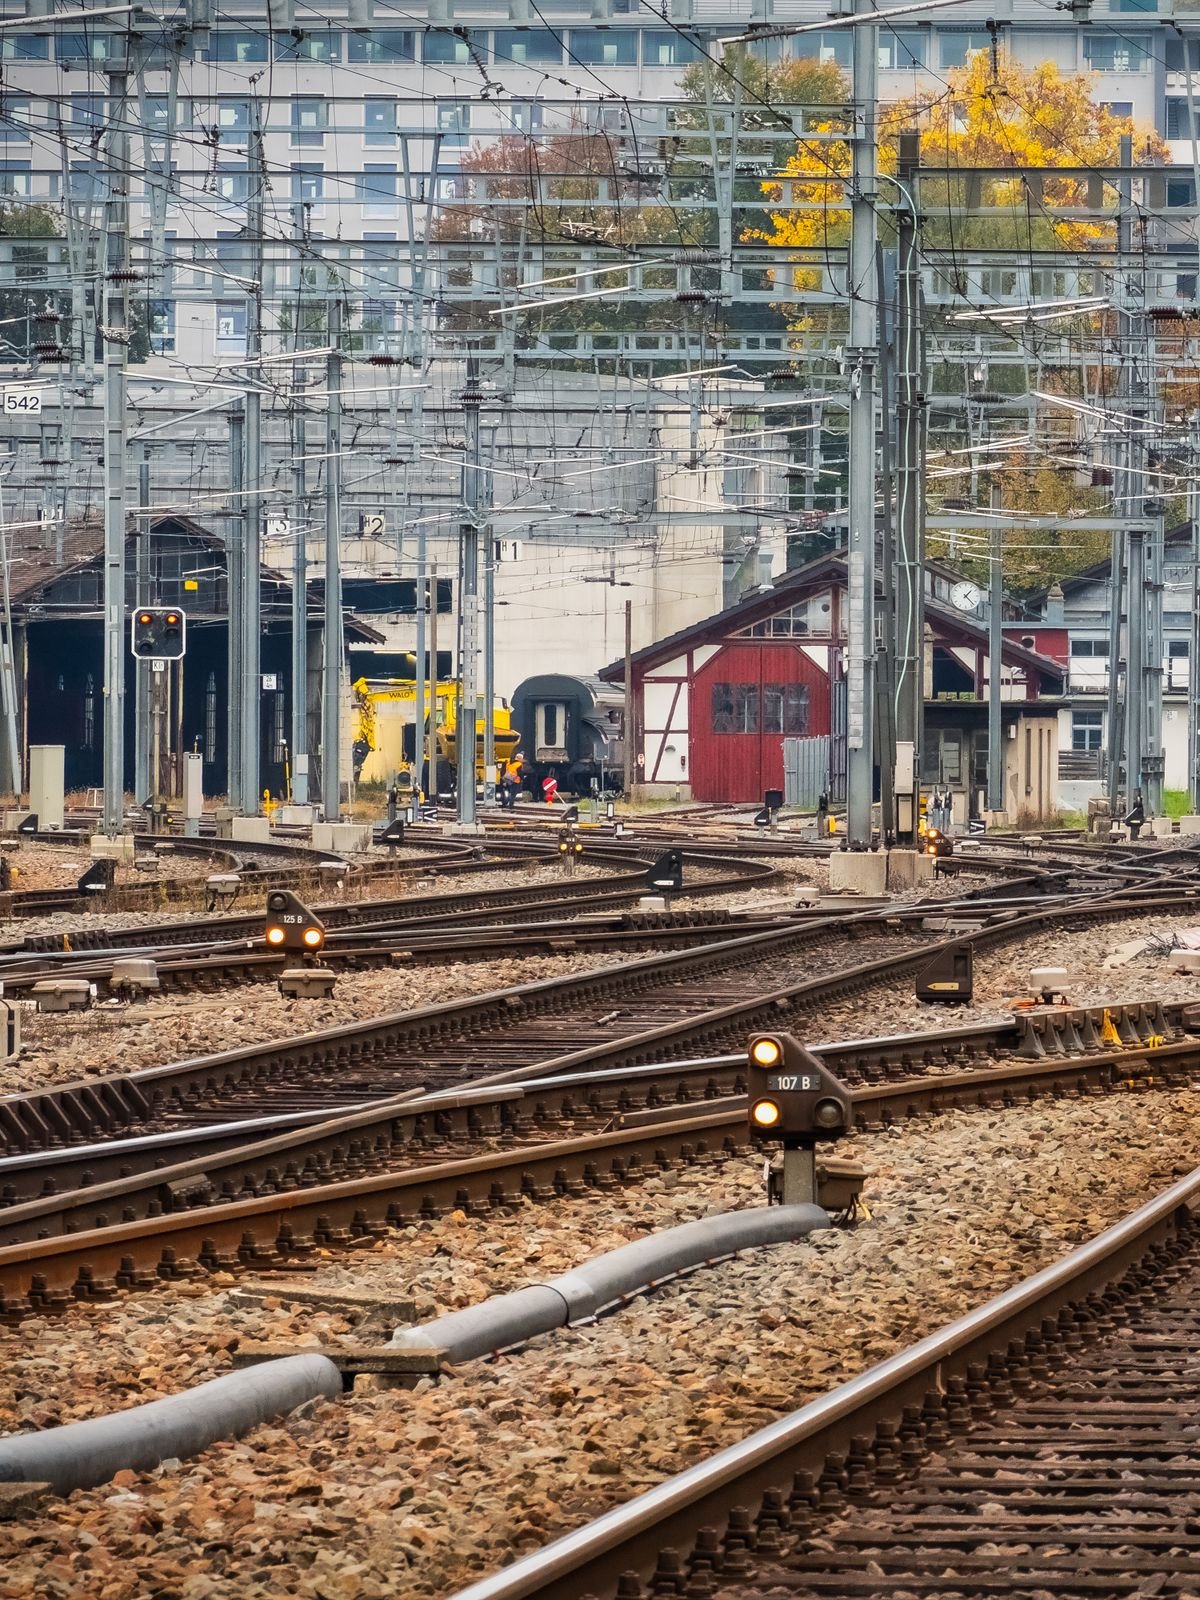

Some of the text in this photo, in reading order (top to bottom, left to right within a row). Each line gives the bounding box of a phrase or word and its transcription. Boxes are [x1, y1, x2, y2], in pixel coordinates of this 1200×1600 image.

[7, 395, 40, 410] 542
[370, 517, 383, 536] 2
[501, 541, 517, 560] H 1
[283, 915, 303, 924] 125 B
[777, 1076, 811, 1090] 107 B
